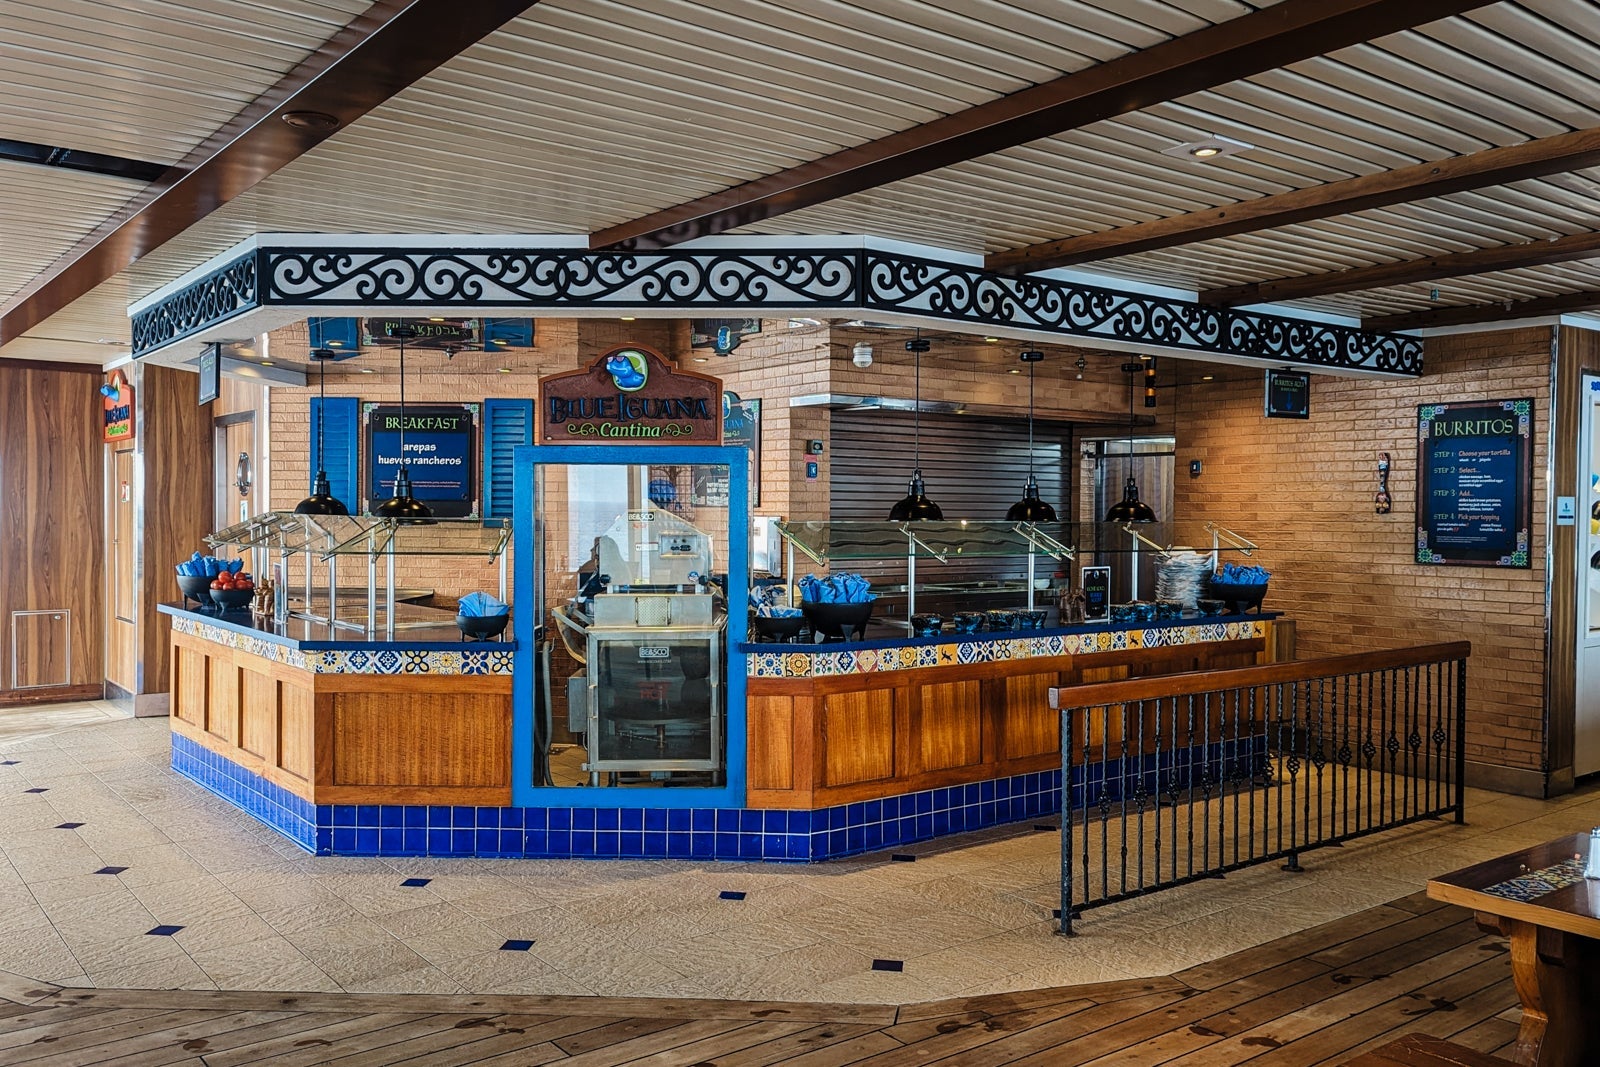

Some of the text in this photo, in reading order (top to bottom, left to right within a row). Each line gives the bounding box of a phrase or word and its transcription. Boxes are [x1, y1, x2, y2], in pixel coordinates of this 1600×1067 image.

[549, 396, 618, 424] BLUE
[617, 393, 712, 422] IGUANA
[385, 416, 459, 430] BREAKFAST
[600, 422, 661, 437] Cantina
[1434, 419, 1514, 437] BURRITOS
[403, 443, 437, 454] arepas
[378, 455, 412, 465] huevos
[1480, 514, 1500, 522] topping
